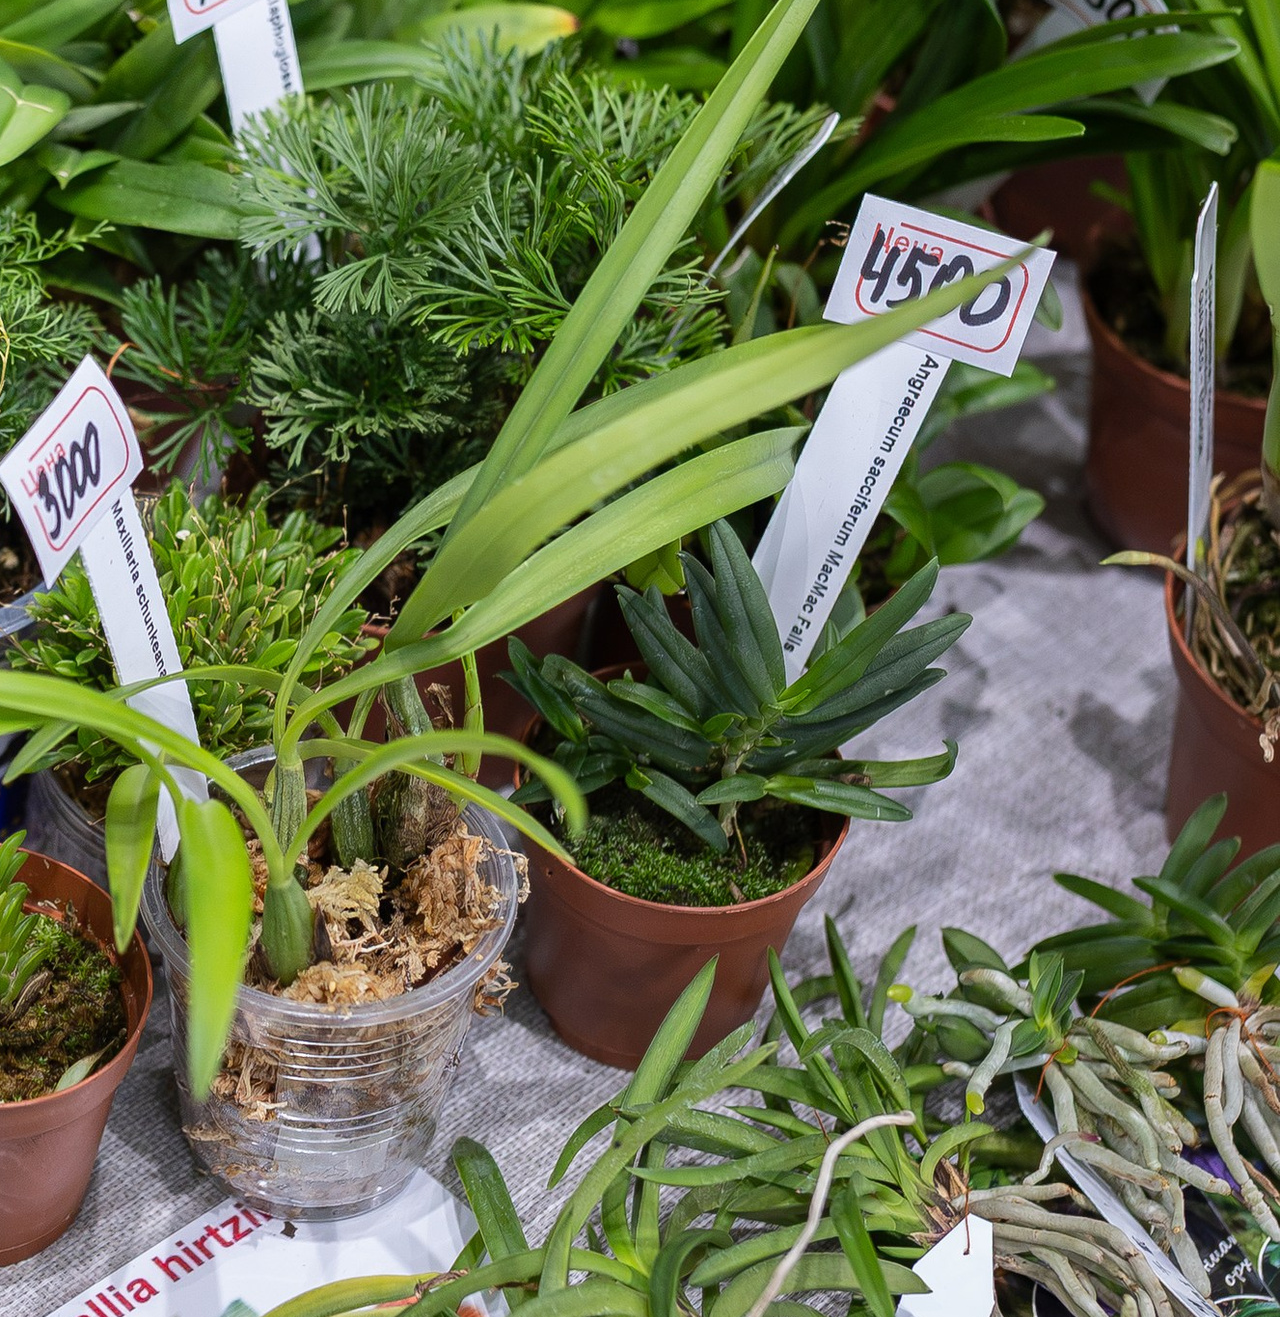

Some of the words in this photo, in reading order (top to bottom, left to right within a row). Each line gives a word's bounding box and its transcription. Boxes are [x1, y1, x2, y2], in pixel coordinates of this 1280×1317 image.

[860, 229, 1011, 327] 4500
[880, 355, 939, 454] Angraecum
[38, 421, 101, 541] 3000
[834, 456, 886, 546] sacciferum
[111, 499, 140, 583] Maxillaria
[136, 584, 168, 678] schunkeana
[802, 551, 844, 615] MacMac
[784, 615, 811, 653] Falls
[152, 1201, 273, 1283] hirtzi
